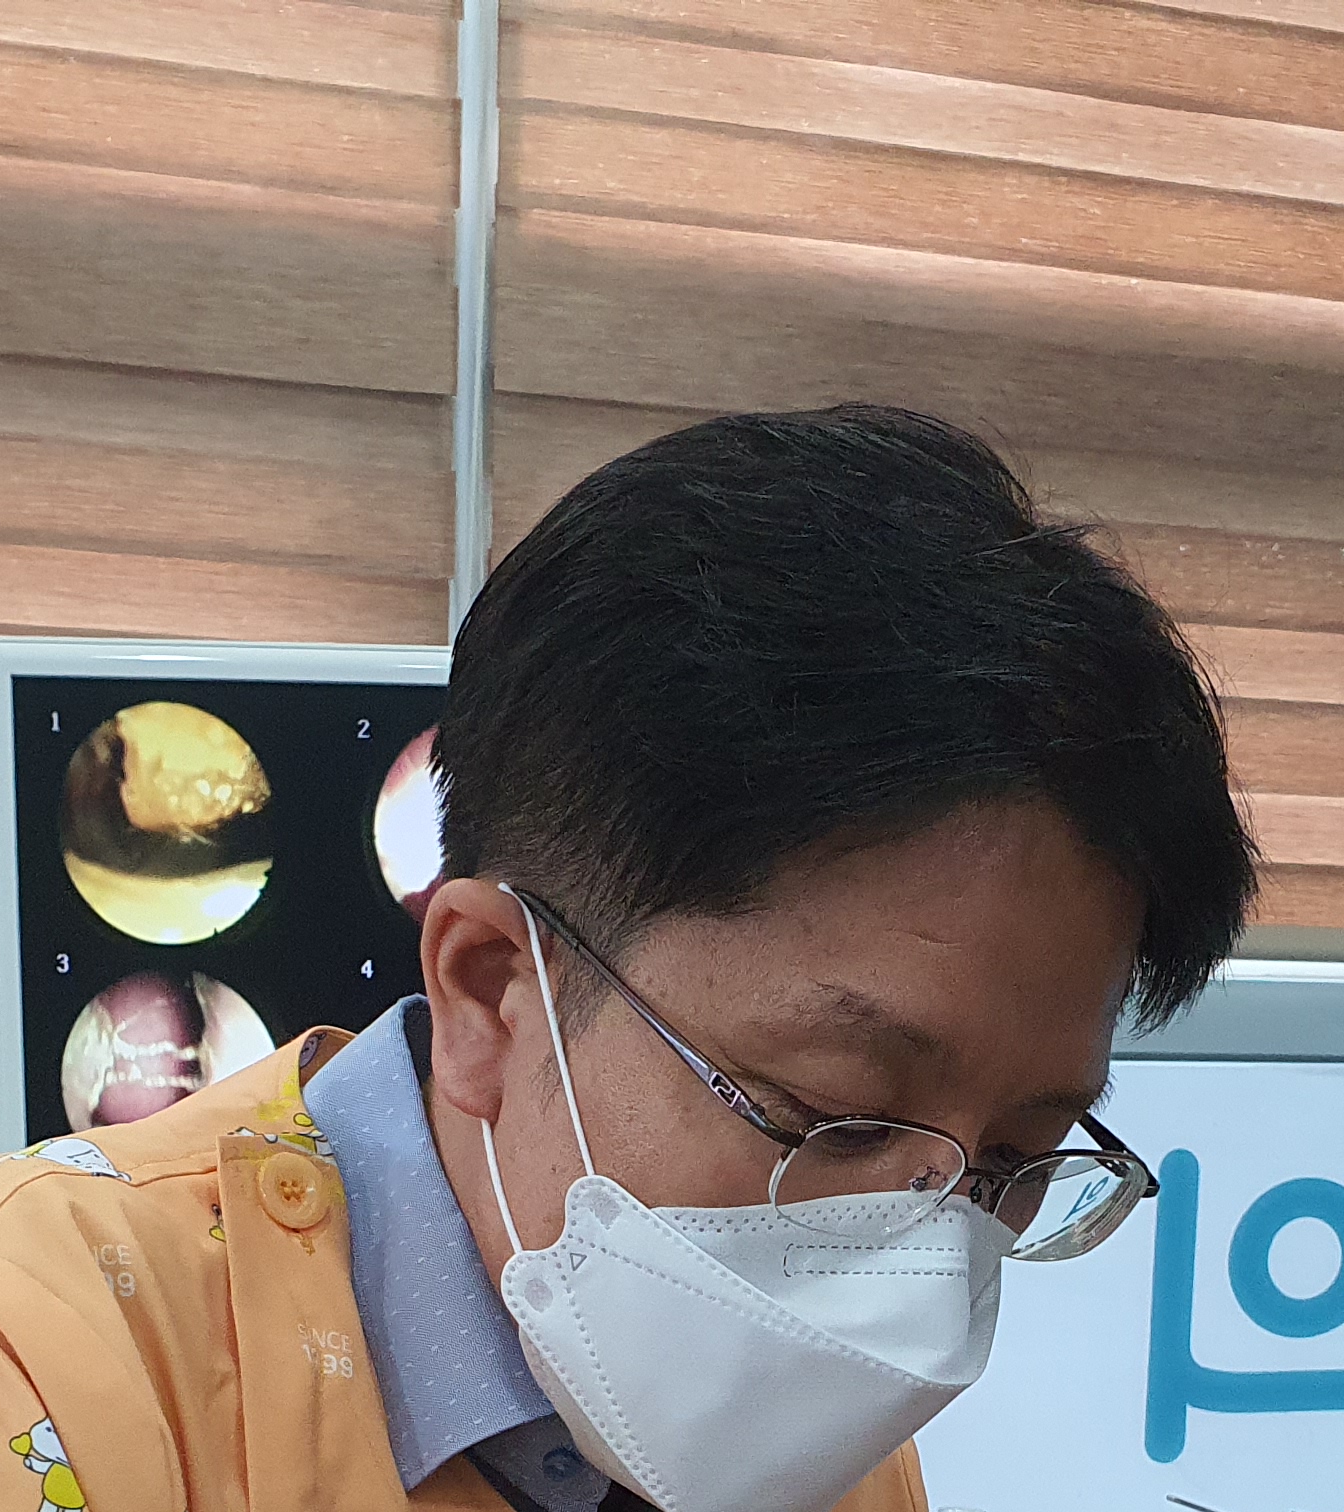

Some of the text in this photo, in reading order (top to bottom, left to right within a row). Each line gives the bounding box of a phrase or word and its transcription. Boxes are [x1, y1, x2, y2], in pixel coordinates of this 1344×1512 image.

[51, 711, 62, 733] 1
[357, 719, 371, 740] 2
[56, 953, 70, 975] 3
[360, 959, 375, 980] 4
